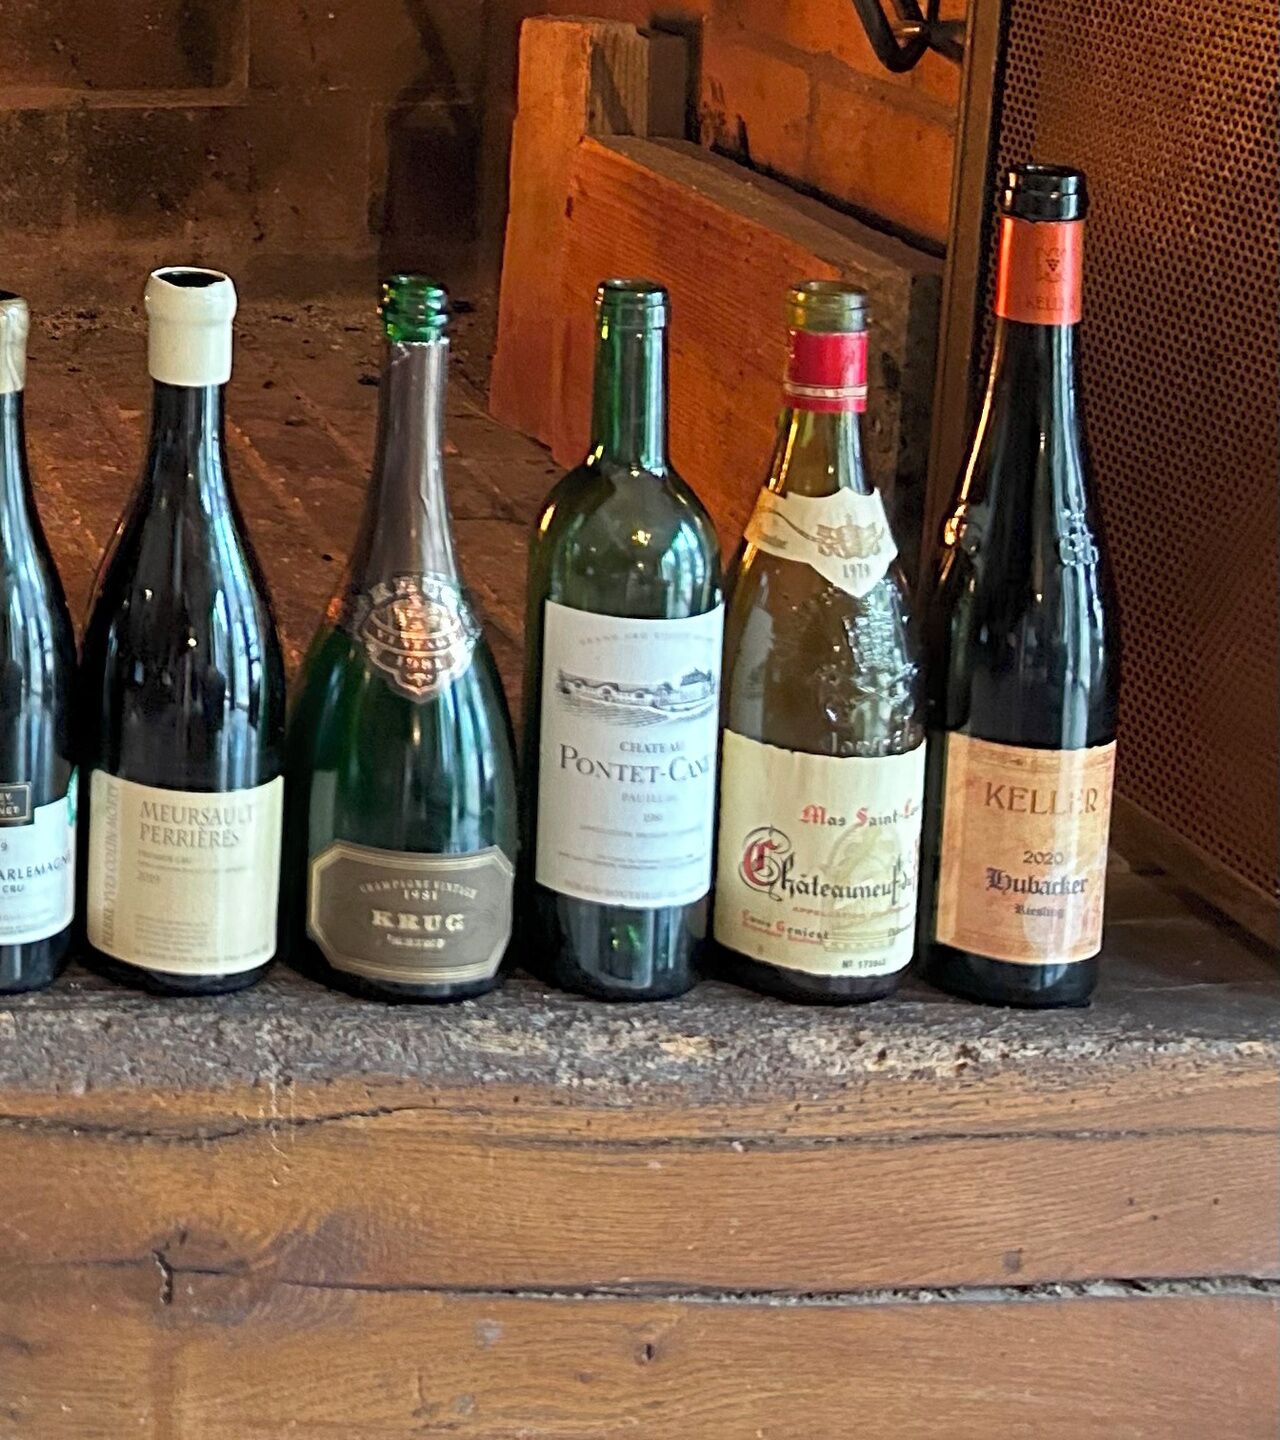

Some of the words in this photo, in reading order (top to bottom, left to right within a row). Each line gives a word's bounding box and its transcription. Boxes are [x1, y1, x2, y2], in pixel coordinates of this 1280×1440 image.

[985, 781, 1098, 815] KELLER
[140, 800, 254, 827] MEURSAULT
[800, 804, 847, 827] Mas
[139, 824, 241, 849] PERRIÈRES
[1022, 849, 1064, 866] 2020
[1, 883, 25, 894] CRU
[985, 866, 1089, 896] Hubacker
[371, 909, 466, 933] KRUG
